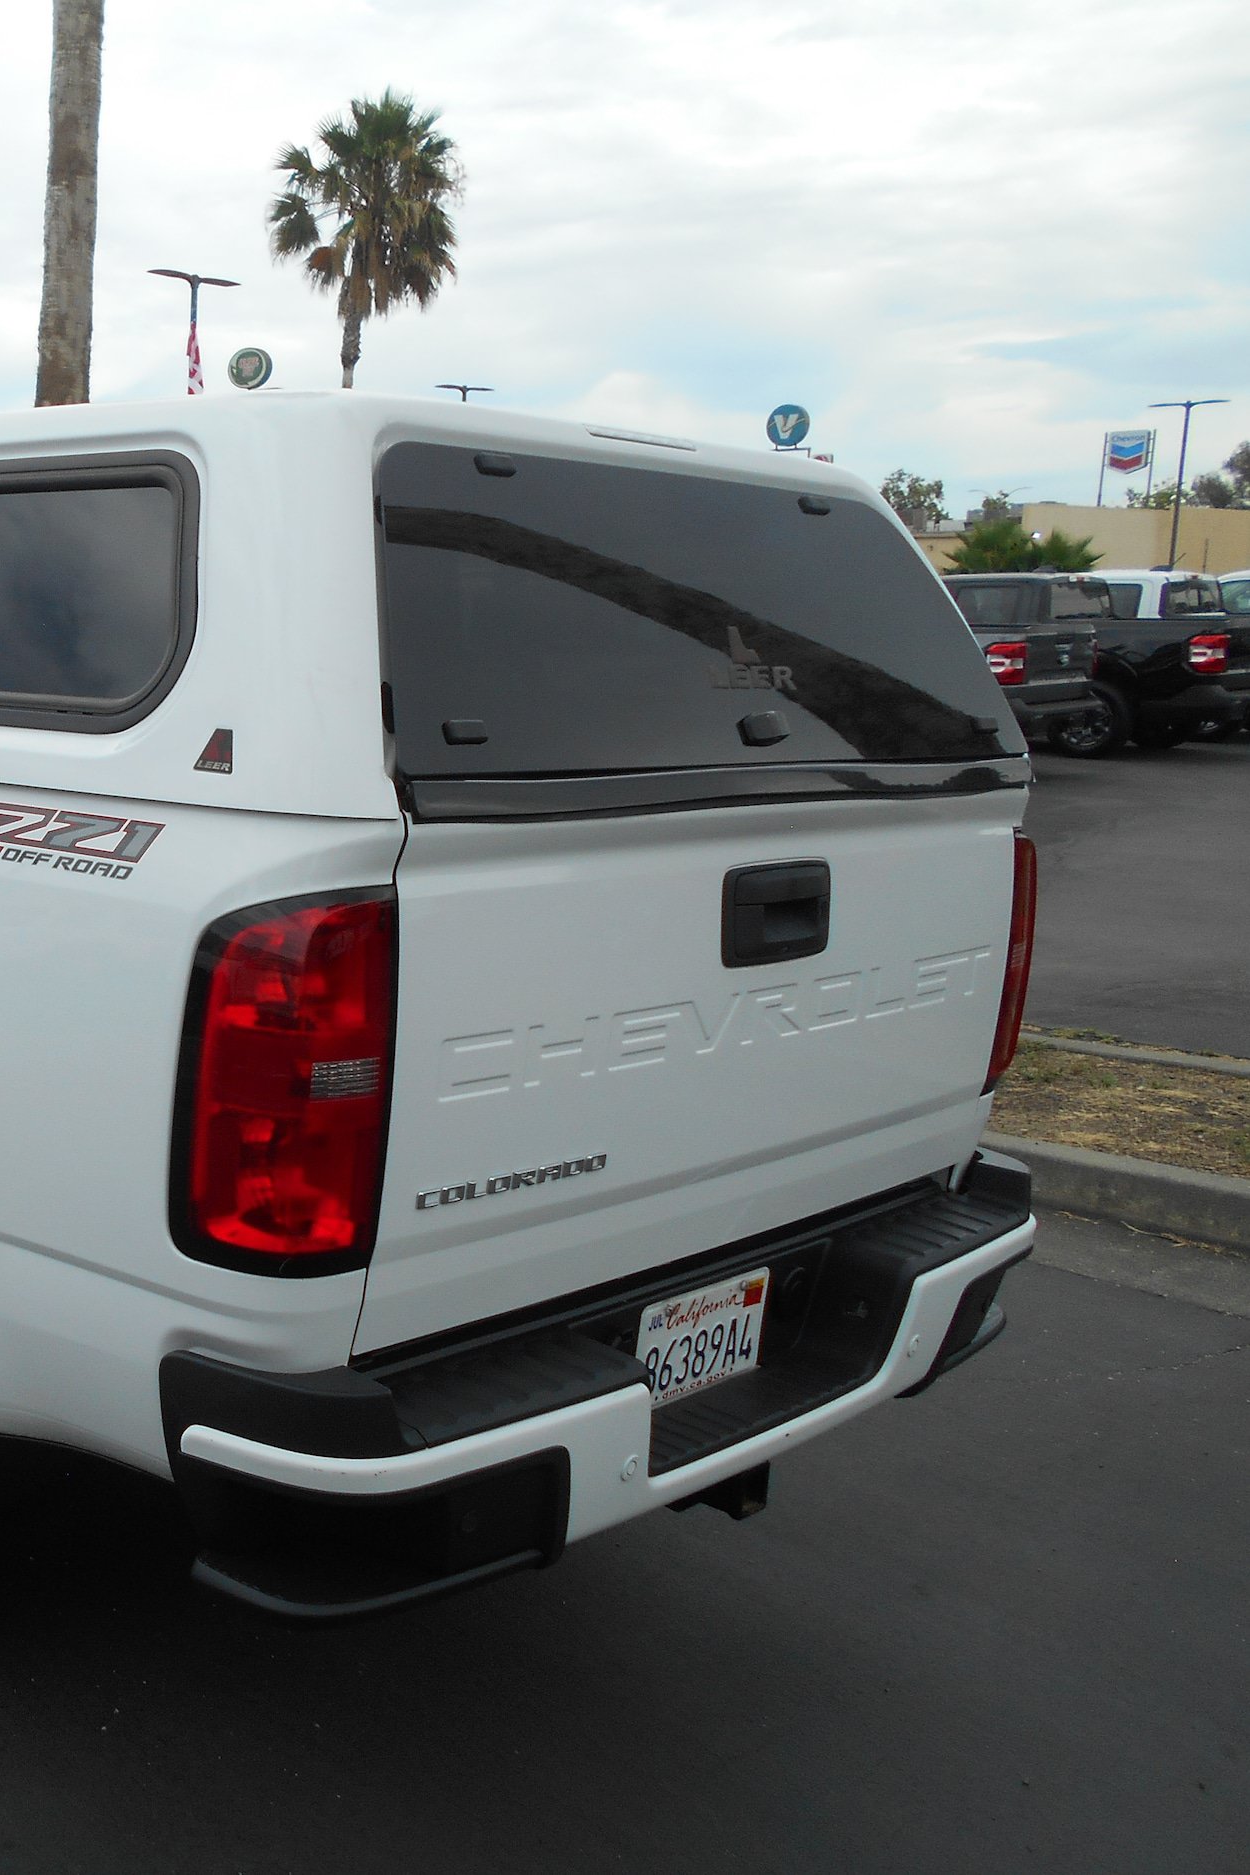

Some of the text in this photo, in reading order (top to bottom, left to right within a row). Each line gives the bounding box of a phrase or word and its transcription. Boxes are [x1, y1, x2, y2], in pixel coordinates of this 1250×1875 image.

[709, 664, 798, 691] LEER
[196, 759, 231, 772] LEER
[1, 848, 134, 881] OFF ROAD
[438, 944, 991, 1104] CHEVROLET
[415, 1152, 608, 1210] COLORADO
[666, 1289, 743, 1331] California
[645, 1313, 753, 1395] 86389A4
